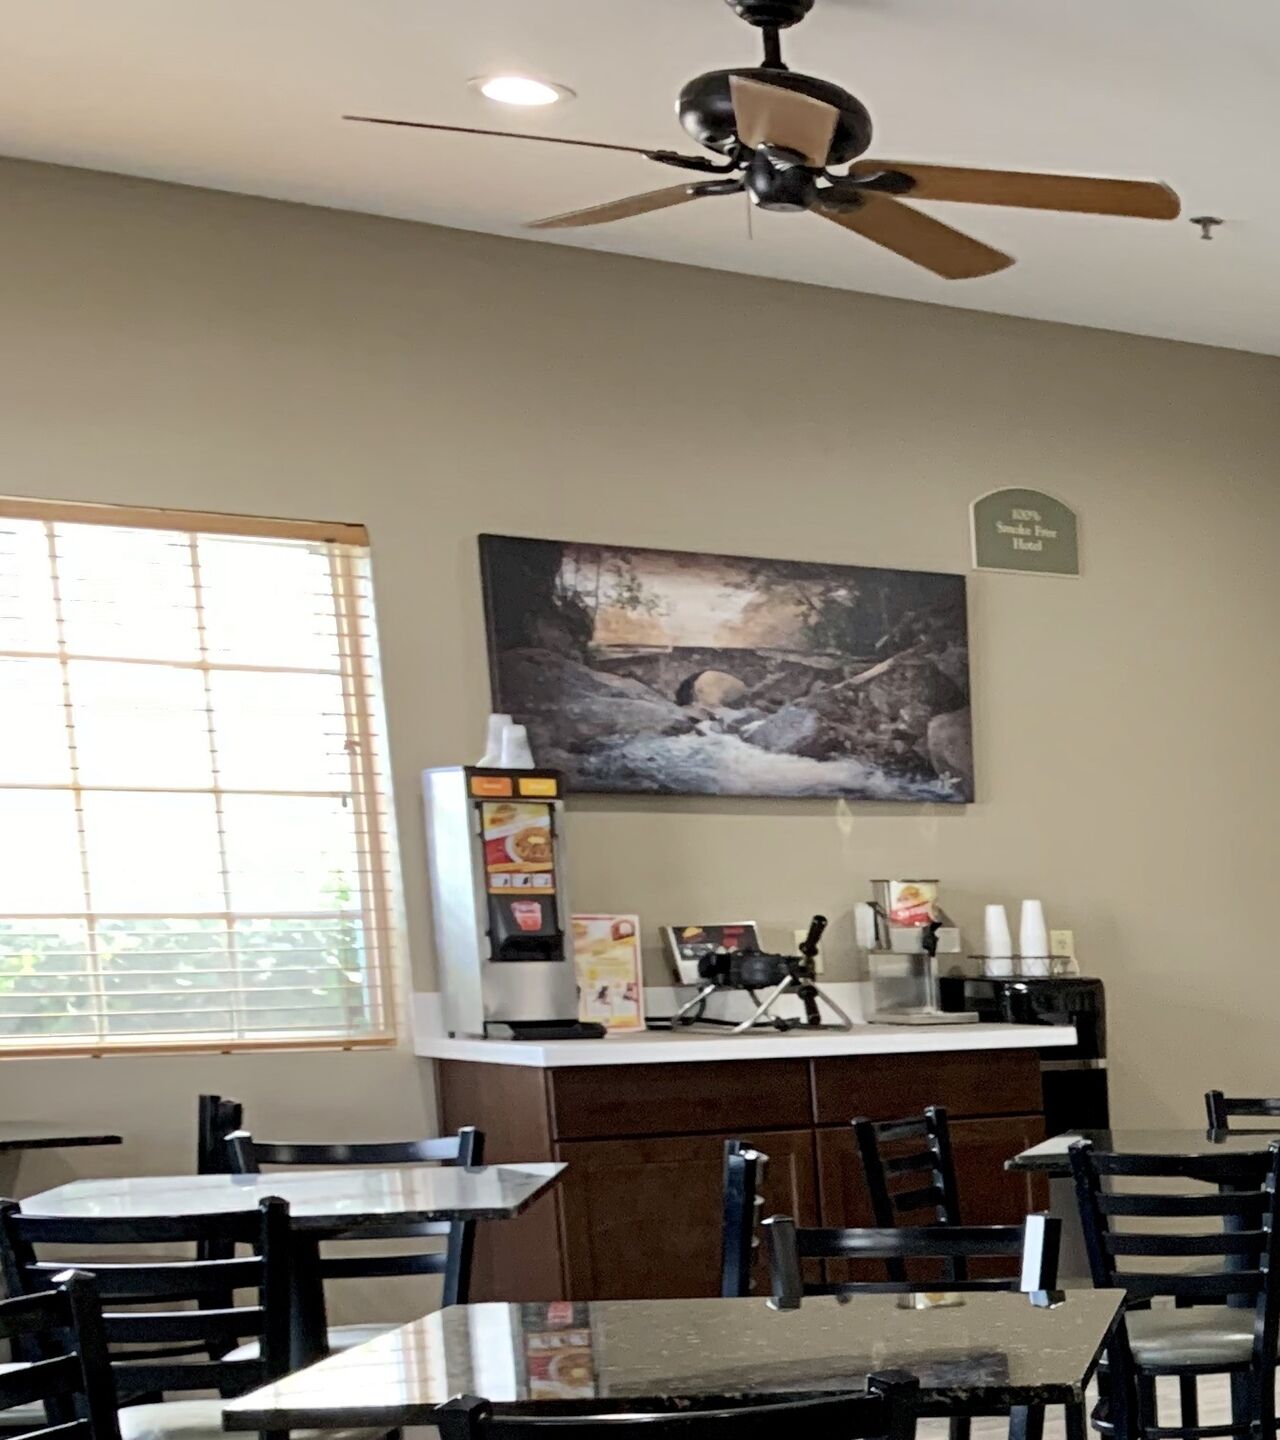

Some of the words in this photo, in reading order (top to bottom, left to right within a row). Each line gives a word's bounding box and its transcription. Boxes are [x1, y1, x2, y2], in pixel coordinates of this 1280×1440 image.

[996, 521, 1032, 536] Smoke
[1034, 525, 1058, 538] Free
[1012, 537, 1043, 551] Hotel
